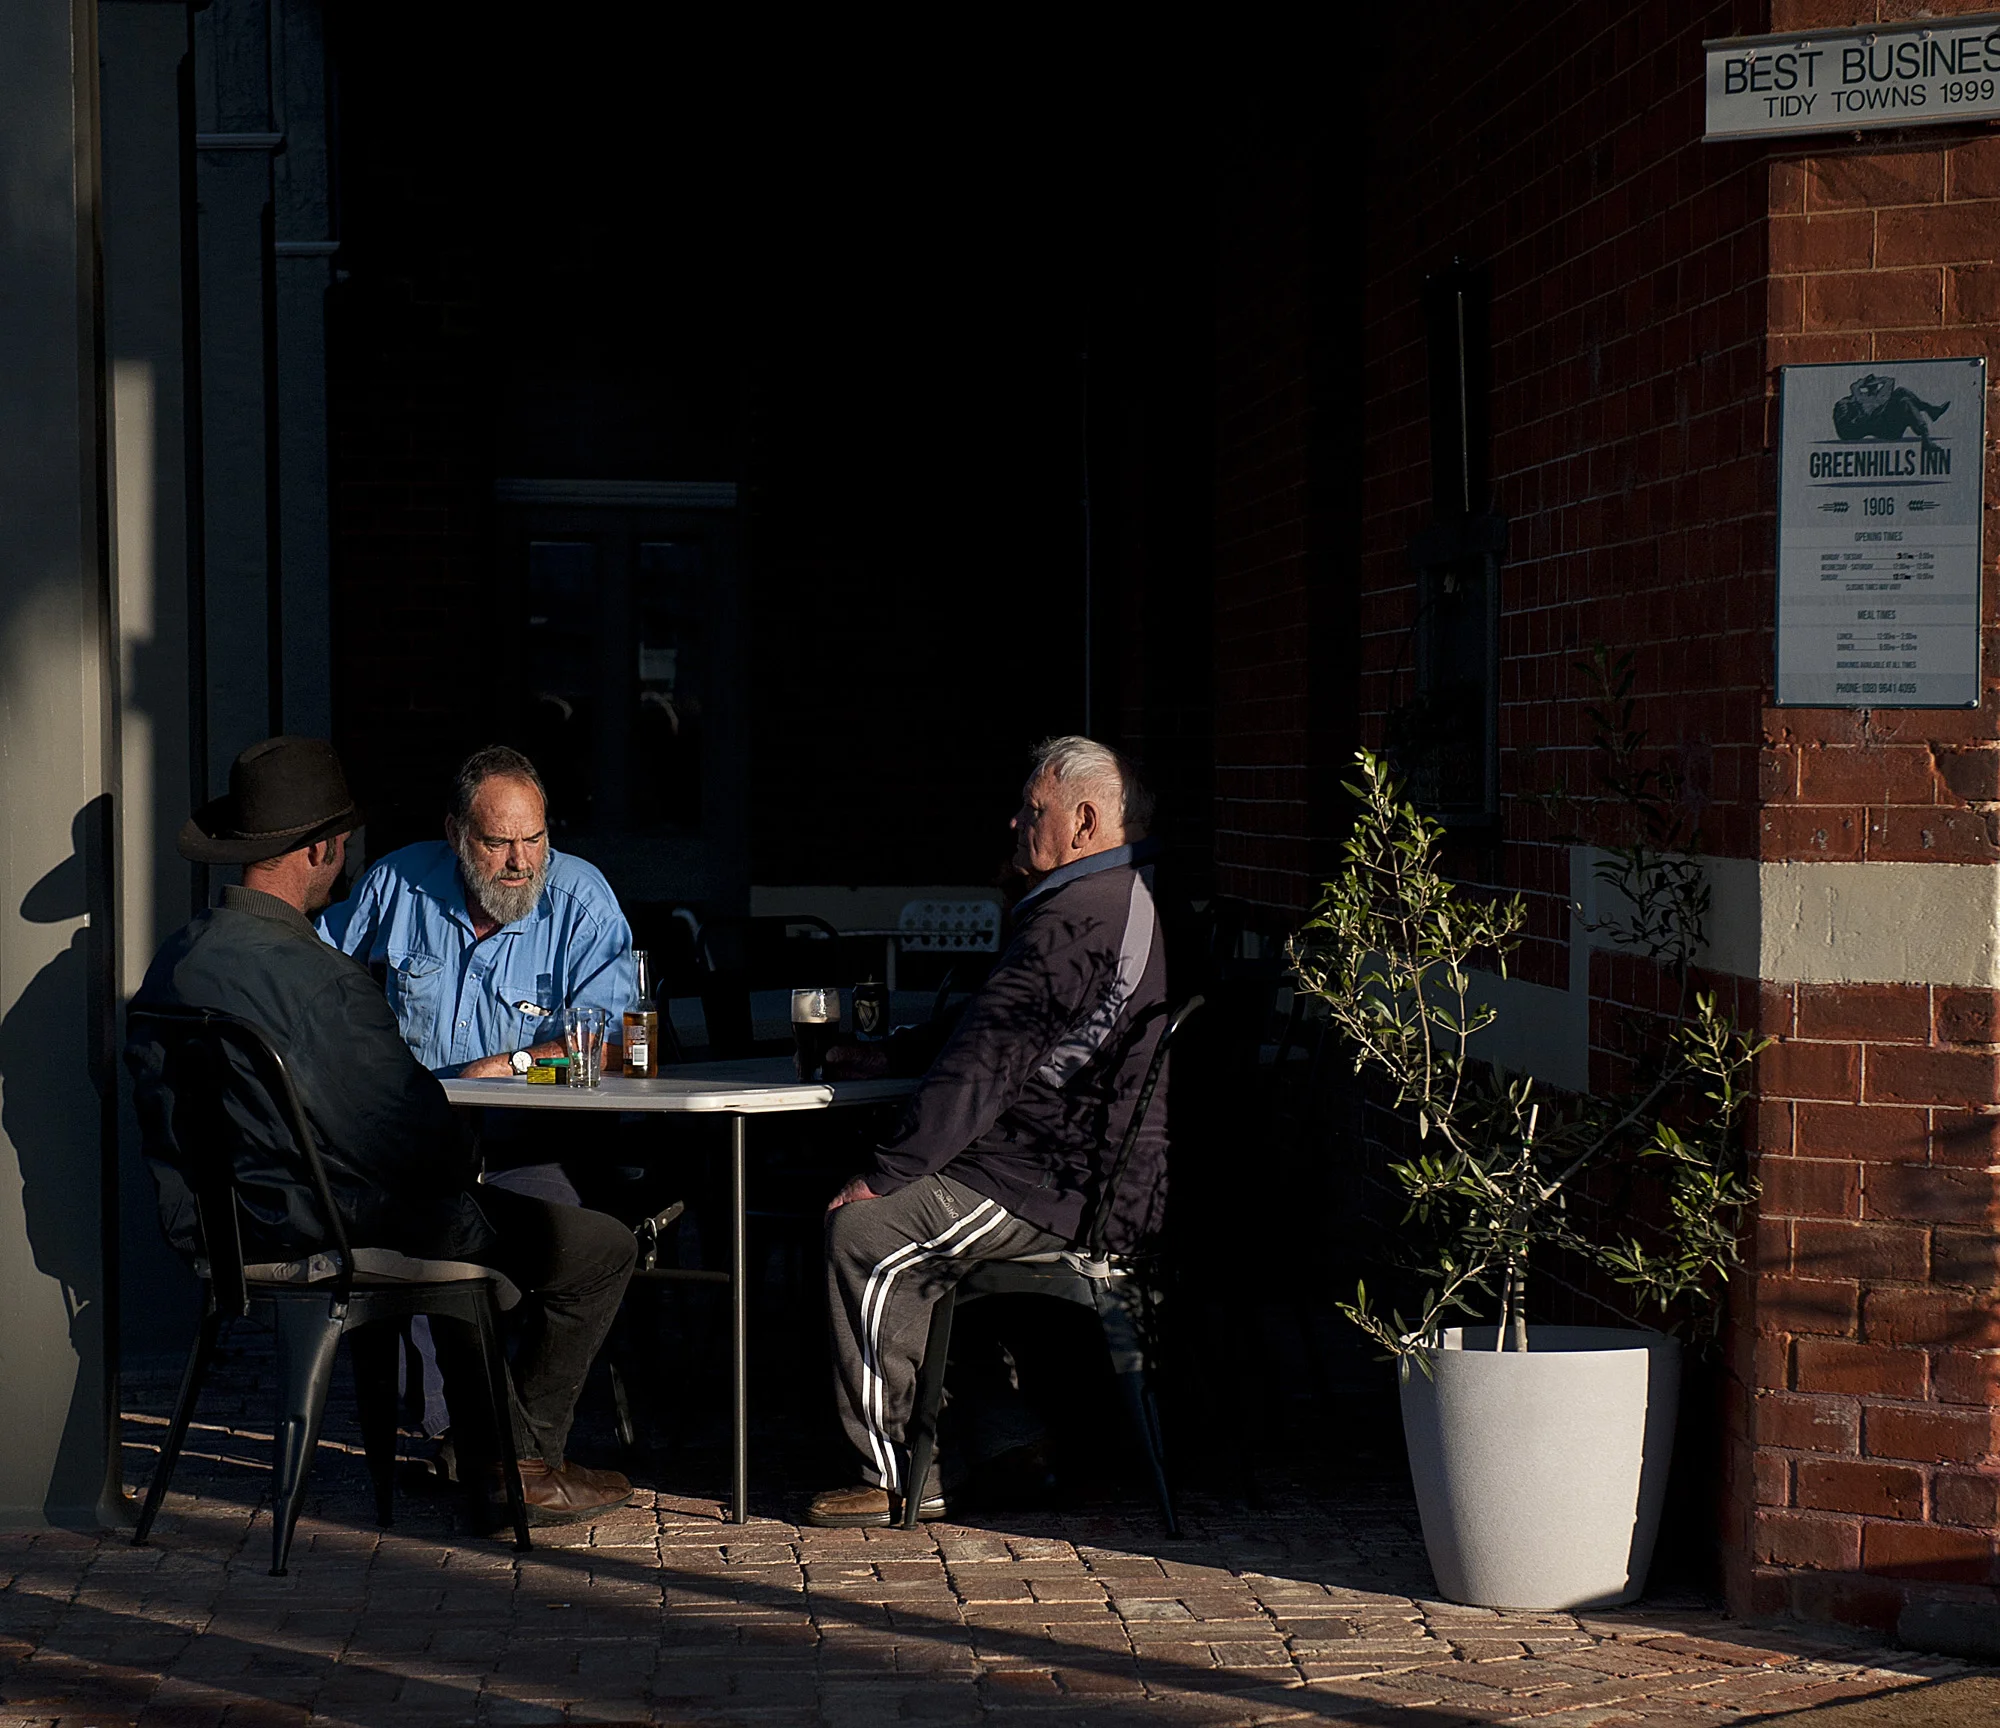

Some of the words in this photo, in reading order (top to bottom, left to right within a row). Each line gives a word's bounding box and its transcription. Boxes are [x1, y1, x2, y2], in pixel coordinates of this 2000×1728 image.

[1724, 50, 1824, 95] BEST
[1763, 93, 1818, 118] TIDY
[1831, 84, 1927, 113] TOWNS
[1939, 79, 1995, 104] 1999
[1809, 448, 1916, 479] GREENHILLS
[1920, 448, 1951, 476] INN
[1862, 497, 1895, 516] 1906
[1854, 532, 1882, 542] OPENING
[1883, 531, 1904, 541] TIMES
[1857, 610, 1876, 619] MEAL
[1877, 610, 1896, 619] TIMES
[1836, 683, 1861, 693] PHONE:
